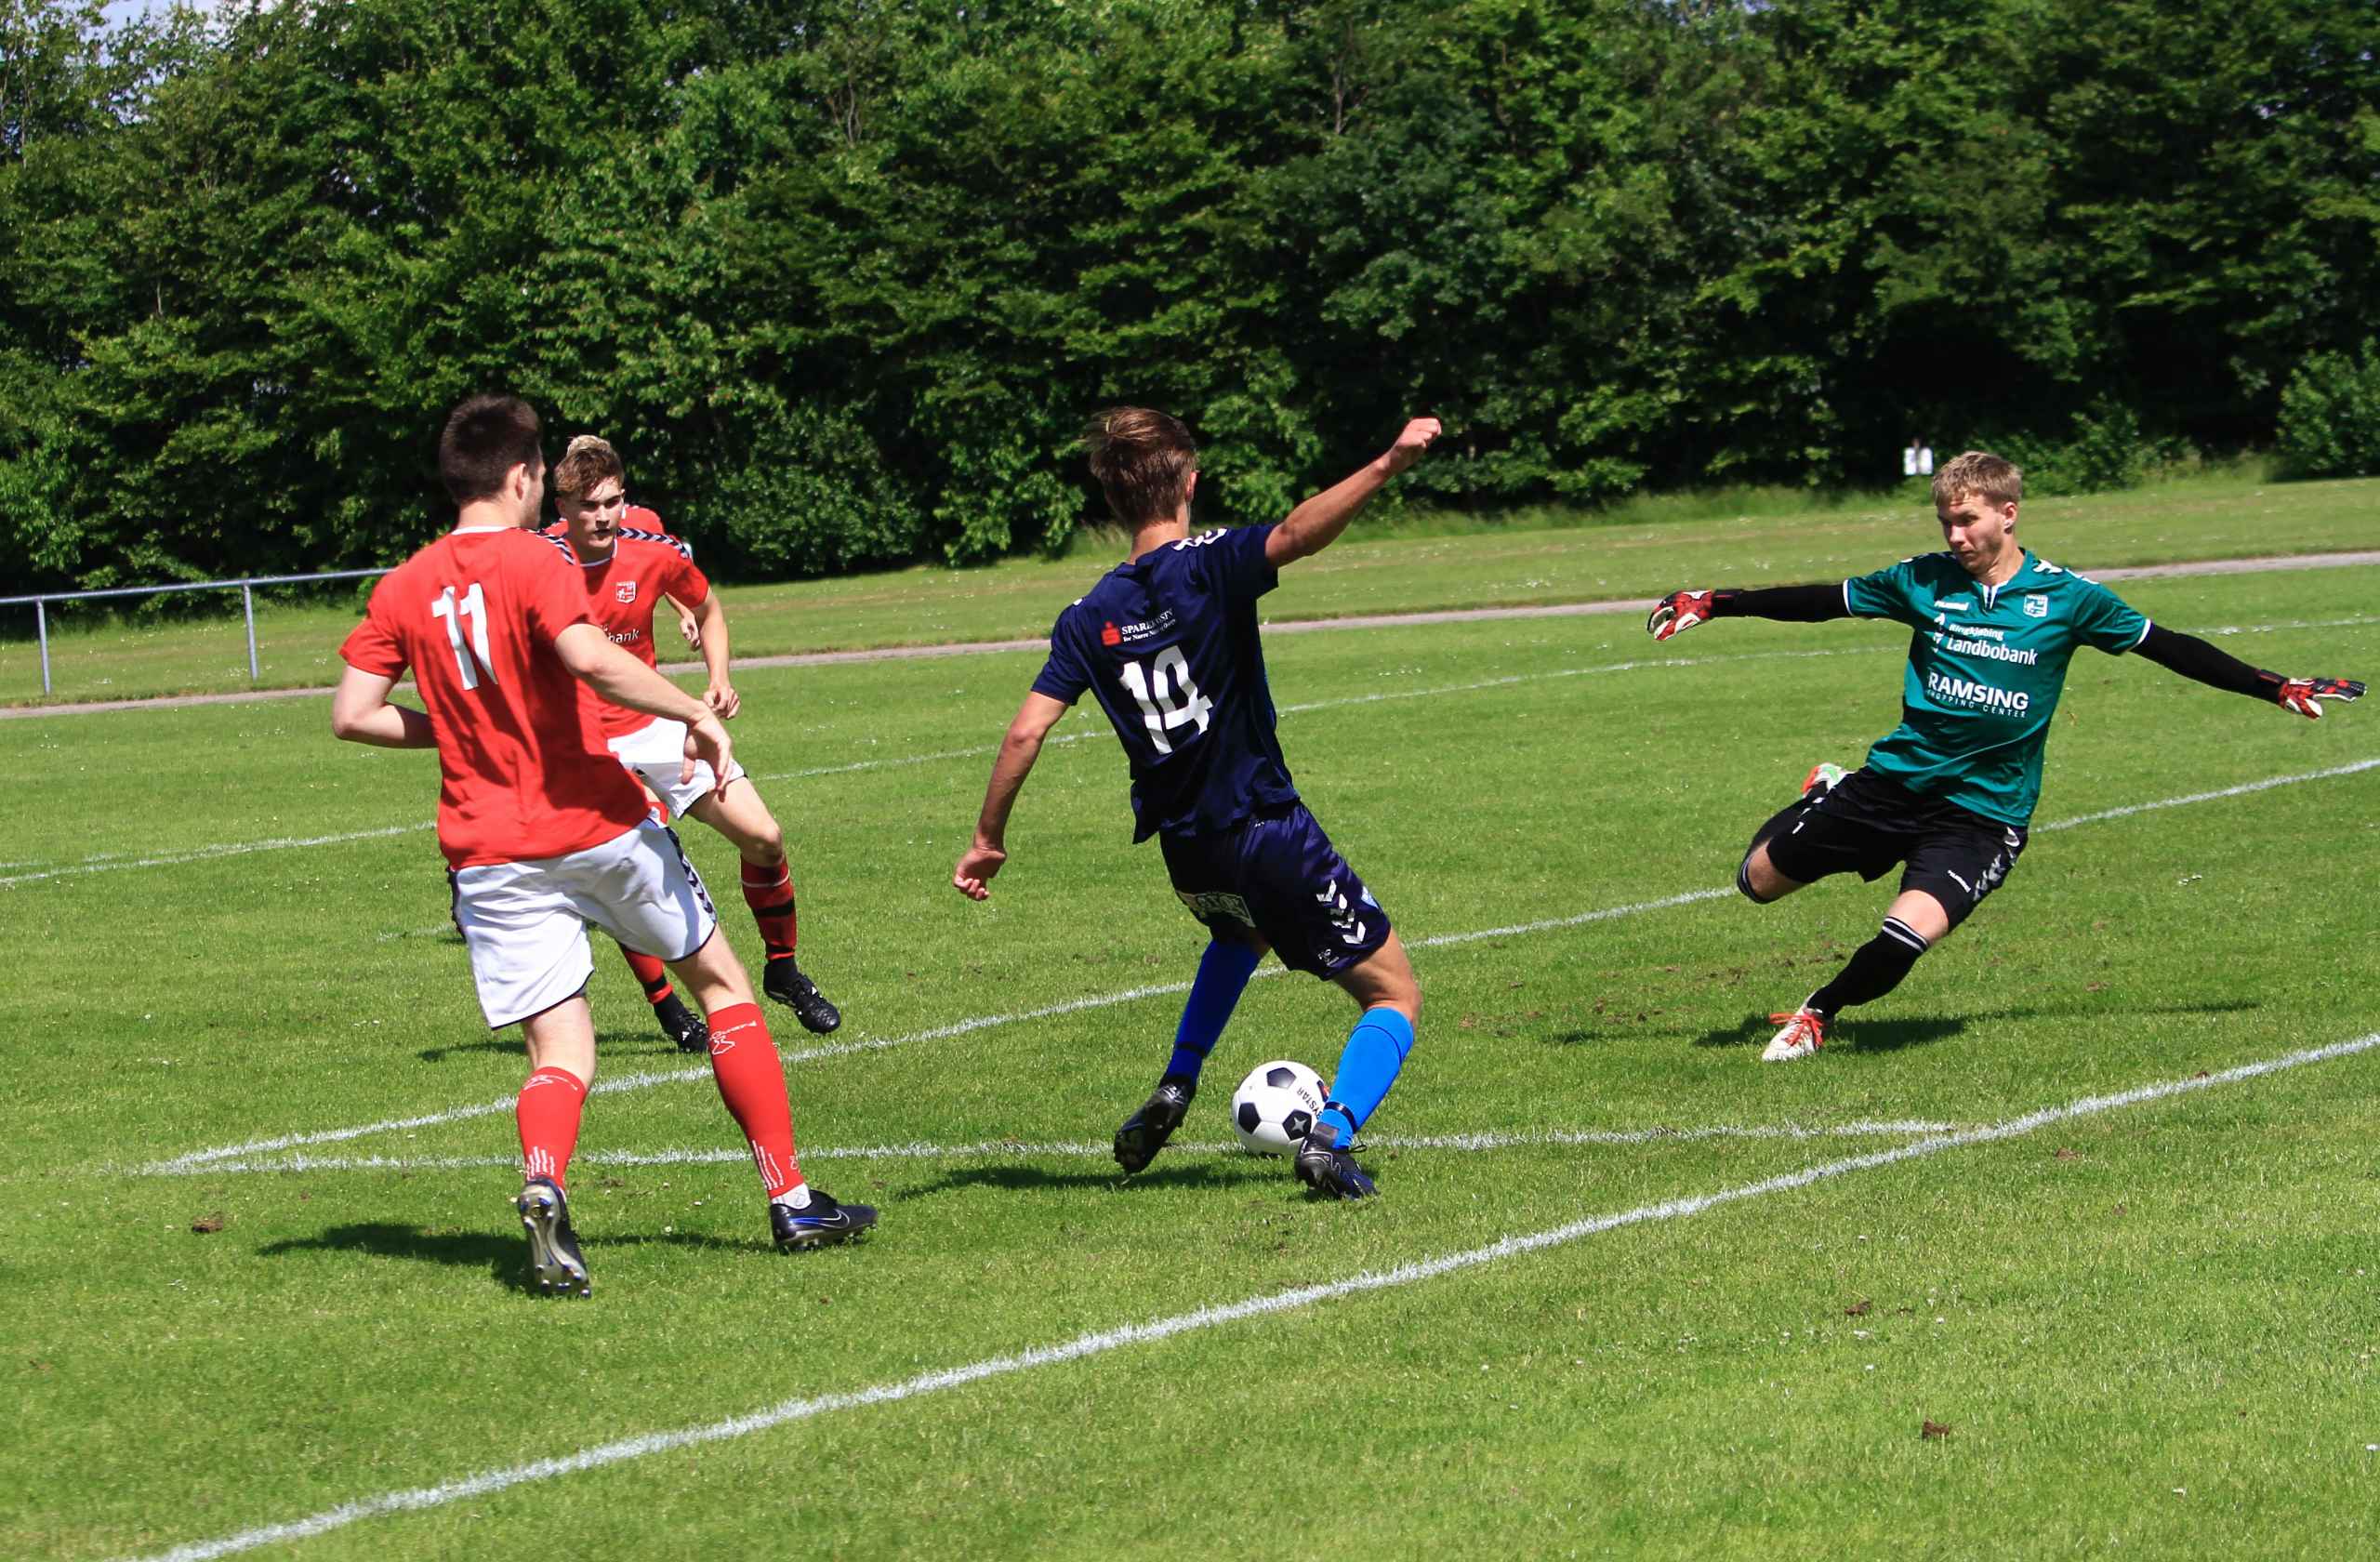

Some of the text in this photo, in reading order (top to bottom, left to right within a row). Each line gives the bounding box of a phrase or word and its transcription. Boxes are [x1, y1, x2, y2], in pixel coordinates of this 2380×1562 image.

[431, 583, 497, 690] 11
[1946, 637, 2039, 666] Landbobank
[1118, 645, 1213, 755] 14
[1927, 671, 2030, 711] RAMSING
[1982, 705, 2027, 719] CENTER
